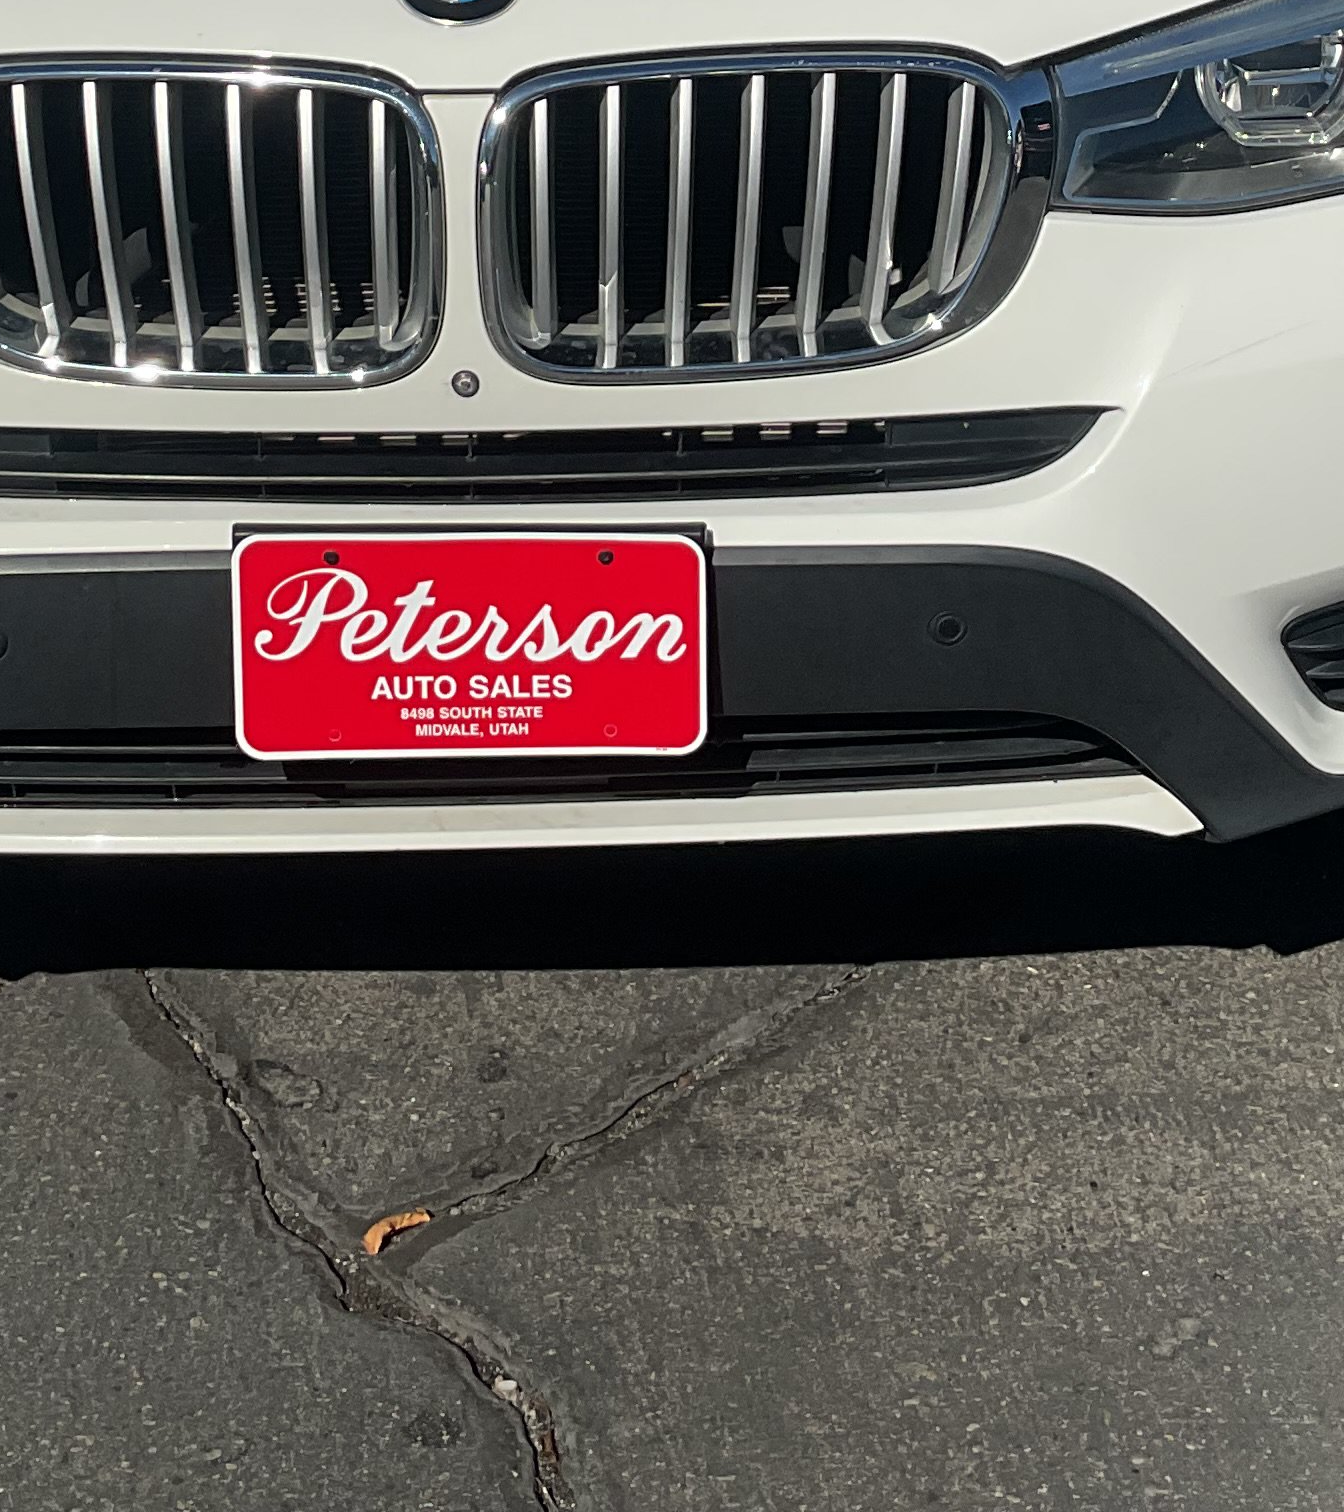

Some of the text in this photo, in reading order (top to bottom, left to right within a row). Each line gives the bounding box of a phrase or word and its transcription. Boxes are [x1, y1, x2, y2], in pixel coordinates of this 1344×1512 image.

[255, 566, 687, 663] Peterson
[371, 674, 573, 700] AUTO SALES
[400, 705, 544, 720] 8498 SOUTH STATE
[415, 722, 529, 737] MIDVALE, UTAH
